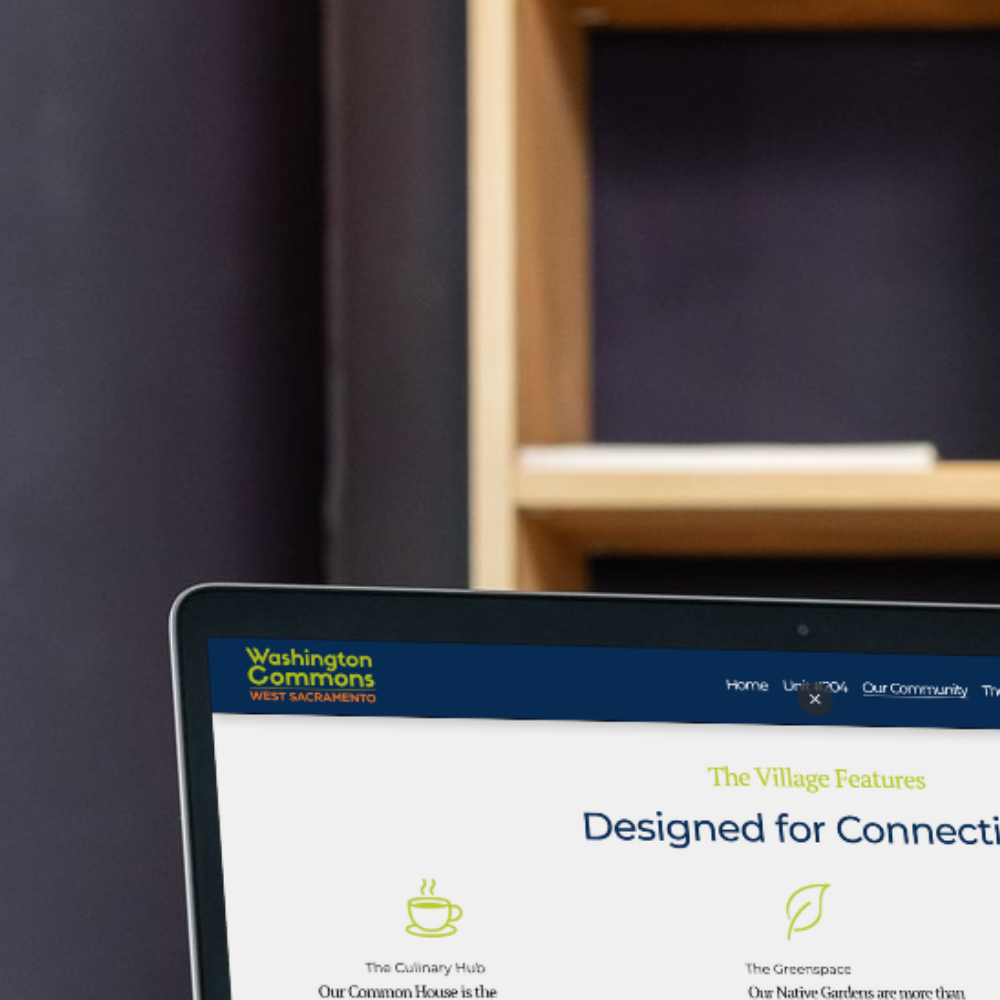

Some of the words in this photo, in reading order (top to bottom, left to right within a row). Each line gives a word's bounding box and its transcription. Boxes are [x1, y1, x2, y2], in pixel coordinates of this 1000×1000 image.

[245, 647, 372, 672] Washington
[247, 665, 375, 687] Commons
[726, 680, 768, 691] Home
[863, 682, 887, 693] Our
[890, 683, 968, 698] Community
[249, 691, 286, 701] WEST
[289, 692, 376, 703] SACRAMENTO
[708, 766, 750, 786] The
[754, 767, 830, 793] Village
[835, 769, 926, 790] Features
[583, 811, 765, 848] Designed
[776, 813, 825, 843] for
[366, 963, 391, 973] The
[395, 963, 452, 976] Culinary
[456, 963, 485, 973] Hub
[747, 963, 770, 974] The
[773, 964, 851, 976] Greenspace
[318, 985, 345, 998] Our
[349, 985, 412, 998] Common
[415, 985, 458, 998] House
[461, 985, 472, 998] is
[475, 985, 497, 998] the
[748, 986, 774, 998] Our
[777, 986, 818, 998] Native
[821, 986, 874, 999] Gardens
[877, 990, 896, 999] are
[899, 990, 933, 999] more
[936, 986, 965, 999] than
